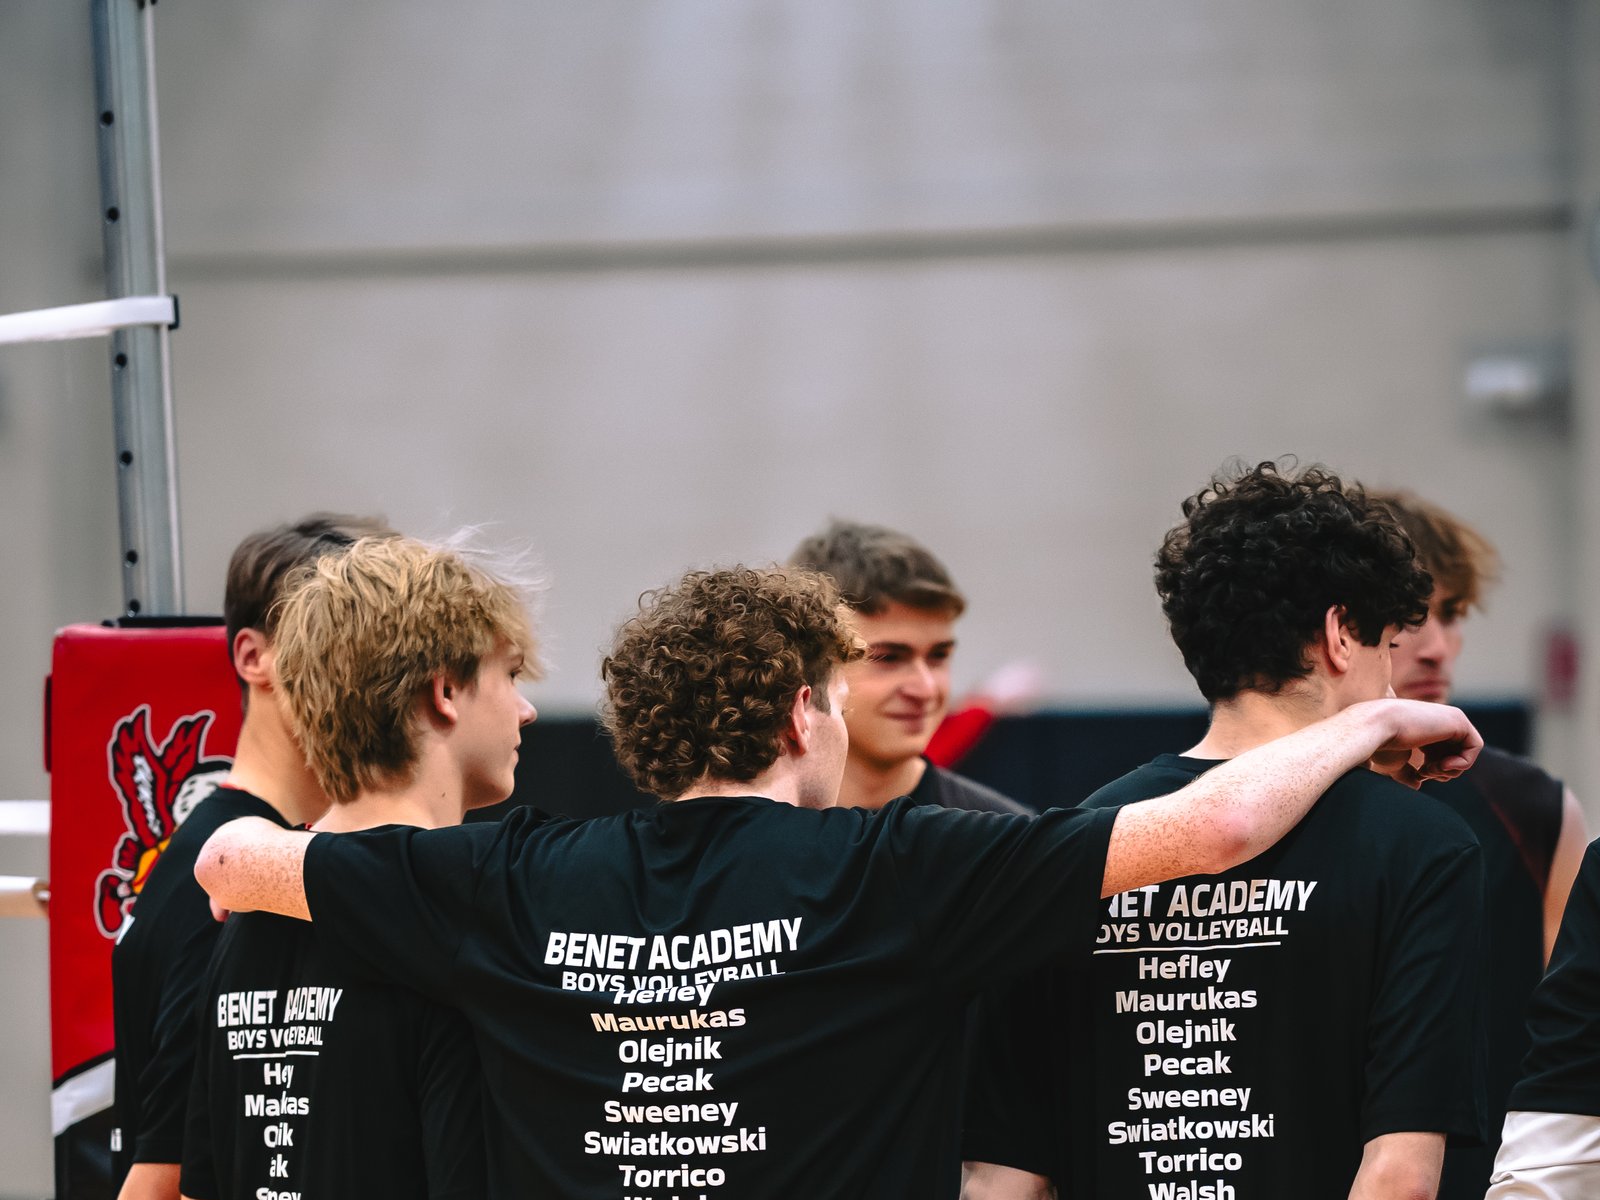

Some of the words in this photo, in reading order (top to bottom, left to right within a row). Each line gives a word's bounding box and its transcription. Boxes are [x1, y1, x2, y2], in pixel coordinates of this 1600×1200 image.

[1166, 879, 1318, 918] ACADEMY
[544, 931, 646, 971] BENET
[647, 916, 803, 971] ACADEMY
[1095, 922, 1140, 944] OYS
[1148, 916, 1289, 942] VOLLEYBALL
[561, 971, 626, 993] BOYS
[1139, 954, 1231, 983] Hefley
[217, 989, 278, 1028] BENET
[1115, 986, 1258, 1014] Maurukas
[591, 1007, 747, 1032] Maurukas
[1136, 1017, 1237, 1049] Olejnik
[227, 1028, 267, 1051] BOYS
[618, 1035, 722, 1068] Olejnik
[1143, 1050, 1232, 1077] Pecak
[622, 1067, 714, 1093] Pecak
[604, 1100, 739, 1127] Sweeney
[1127, 1087, 1252, 1112] Sweeney
[584, 1126, 767, 1156] Swiatkowski
[1107, 1113, 1275, 1145] Swiatkowski
[1138, 1147, 1242, 1174] Torrico
[618, 1163, 726, 1188] Torrico
